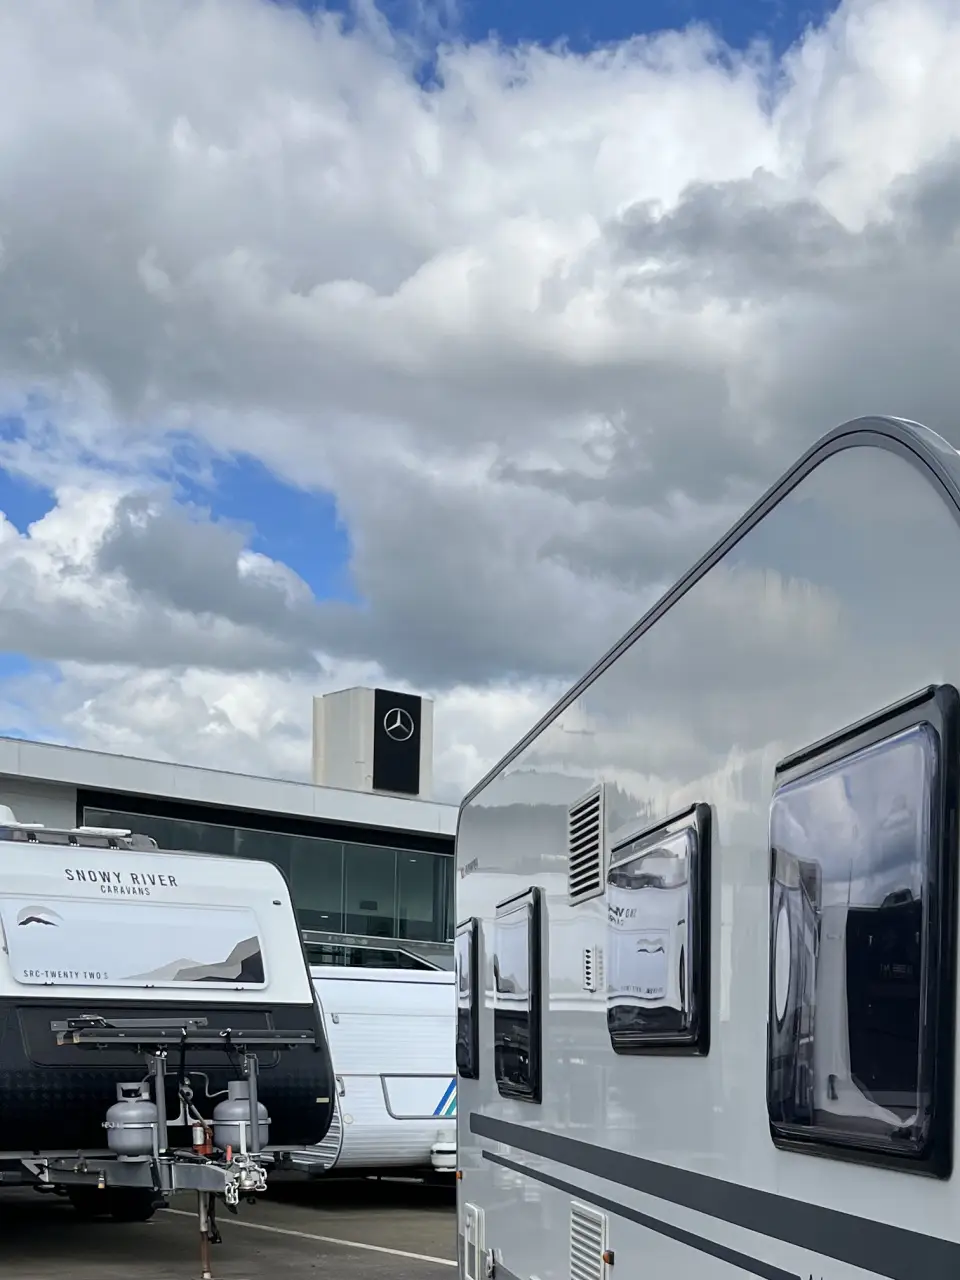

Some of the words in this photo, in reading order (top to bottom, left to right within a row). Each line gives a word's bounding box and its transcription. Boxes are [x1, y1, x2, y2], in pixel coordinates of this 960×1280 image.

[64, 868, 121, 884] SNOWY
[130, 873, 178, 887] RIVER
[100, 885, 151, 896] CARAVANS
[23, 969, 80, 979] SRC-TWENTY
